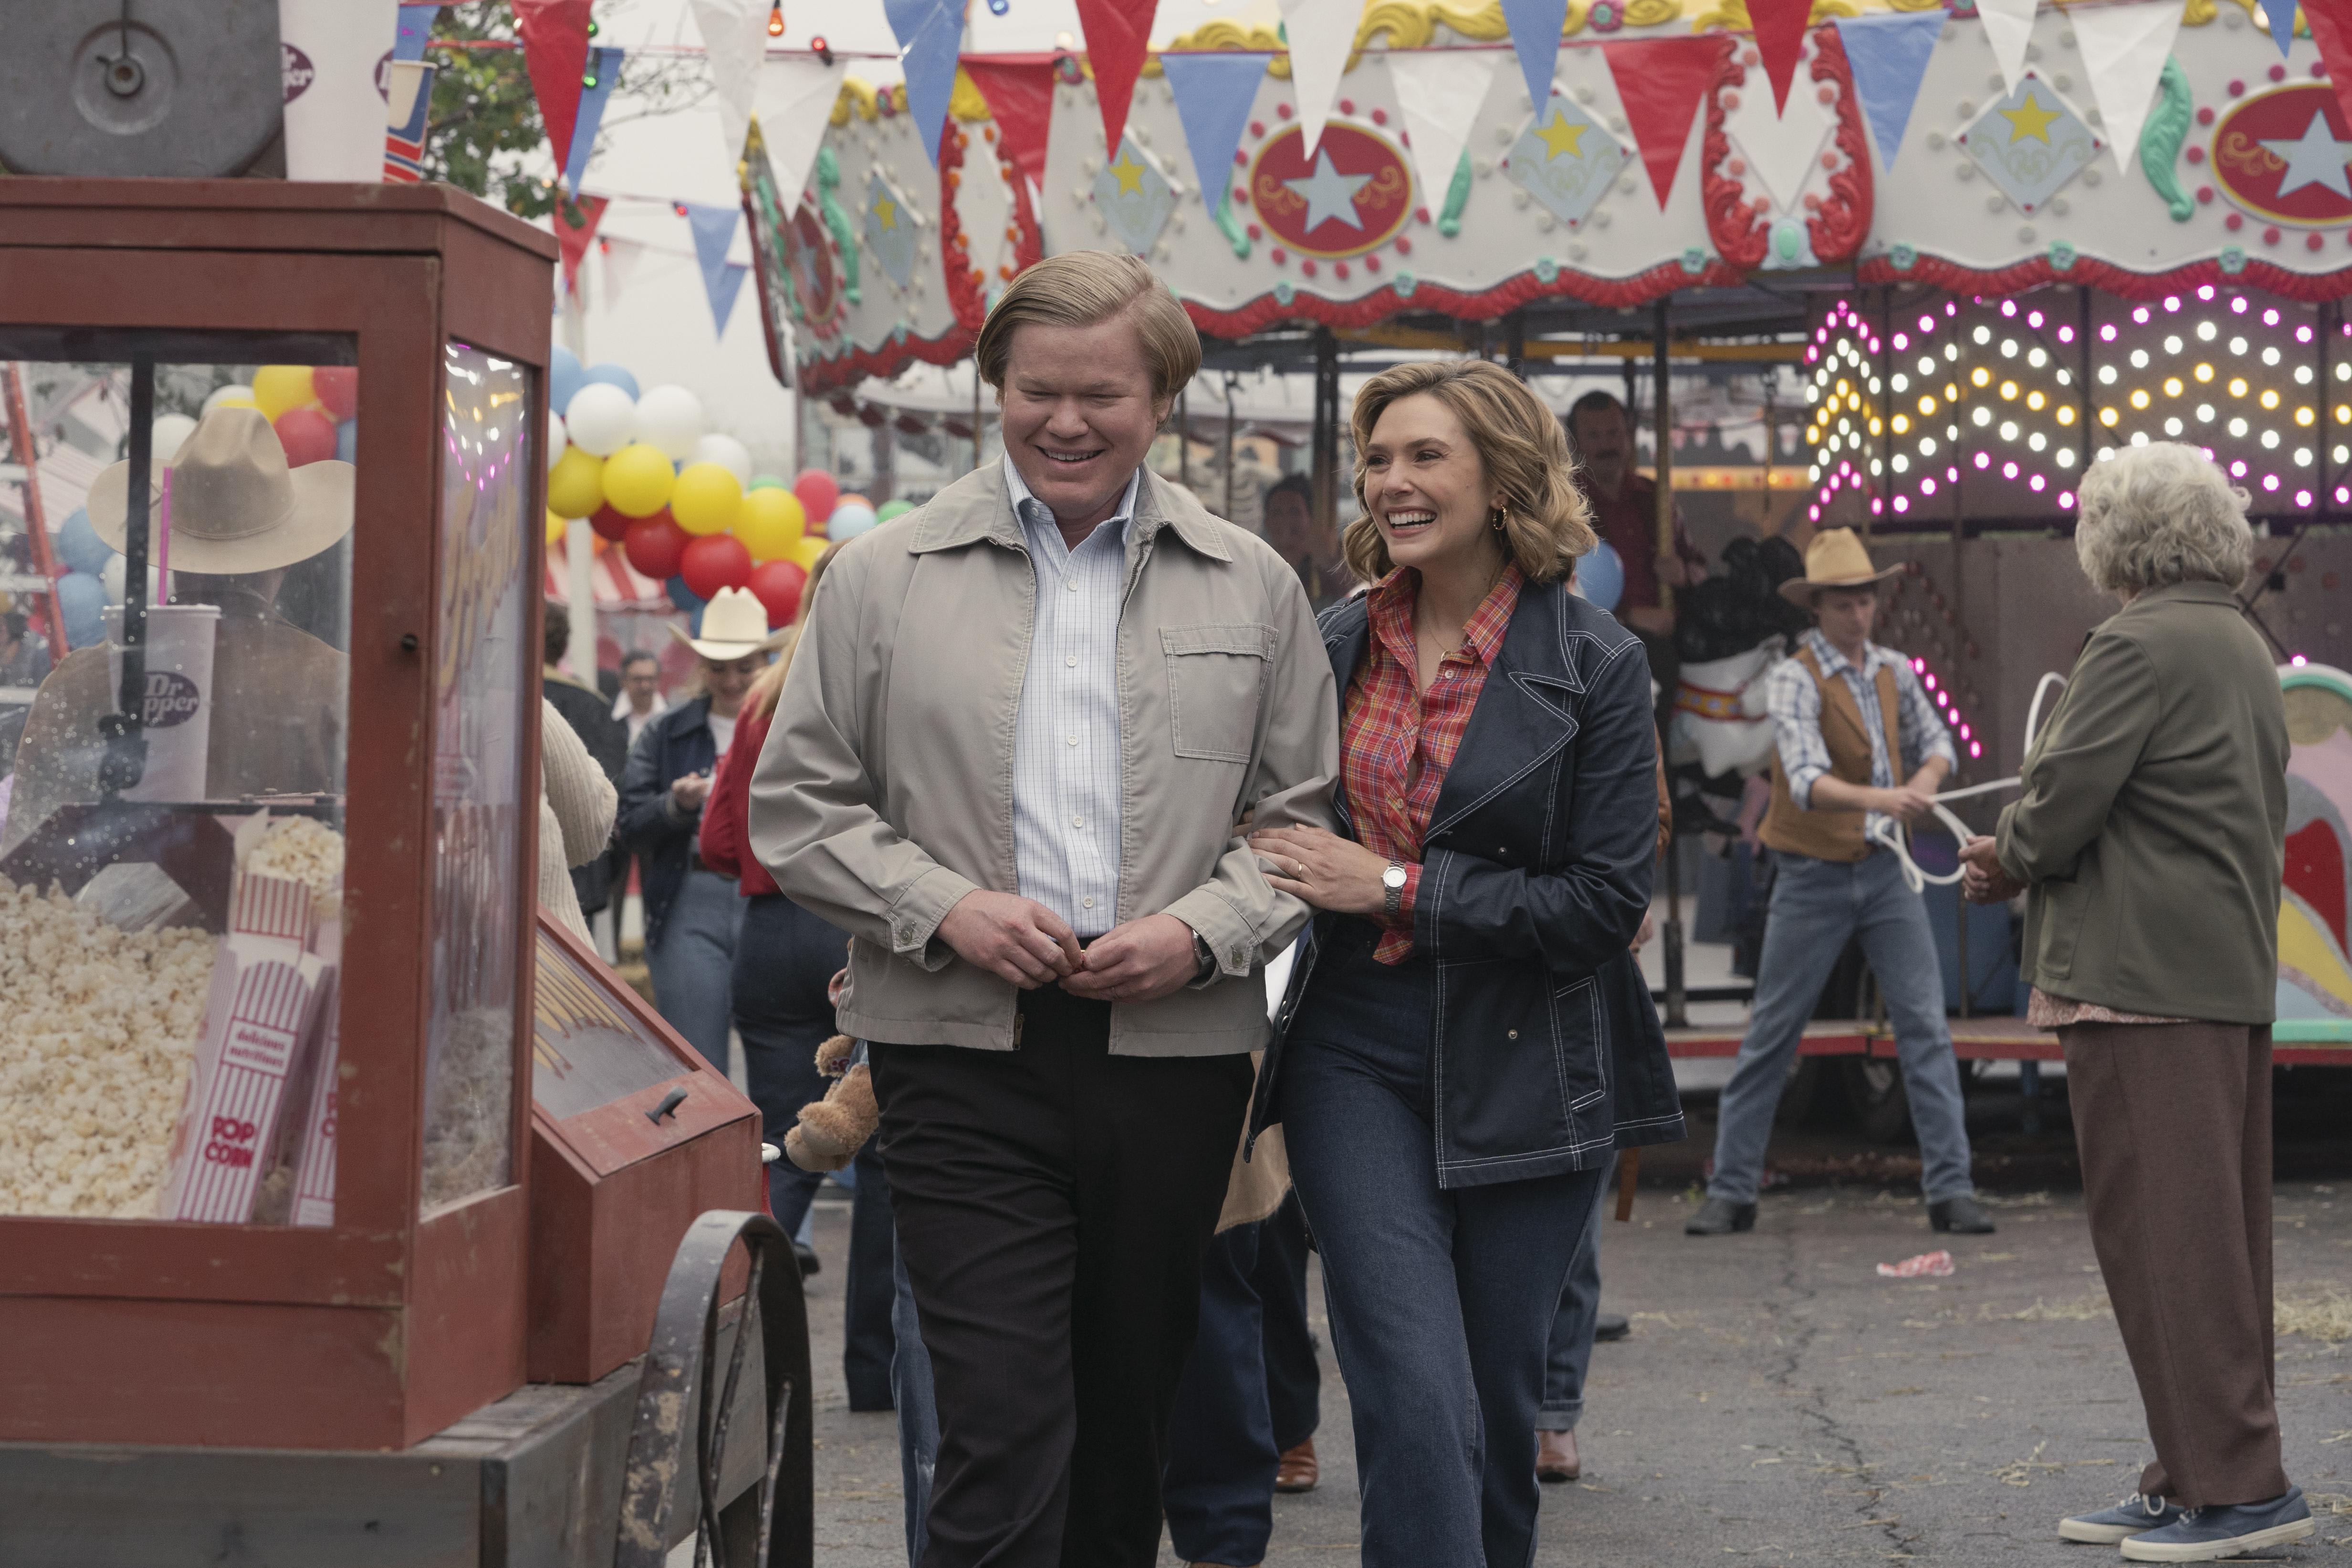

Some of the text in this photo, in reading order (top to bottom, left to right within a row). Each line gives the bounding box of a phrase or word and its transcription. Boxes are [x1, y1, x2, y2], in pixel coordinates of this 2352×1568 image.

[147, 674, 184, 696] Dr
[144, 696, 198, 721] pper
[213, 1115, 255, 1144] POP
[205, 1142, 254, 1168] CORN
